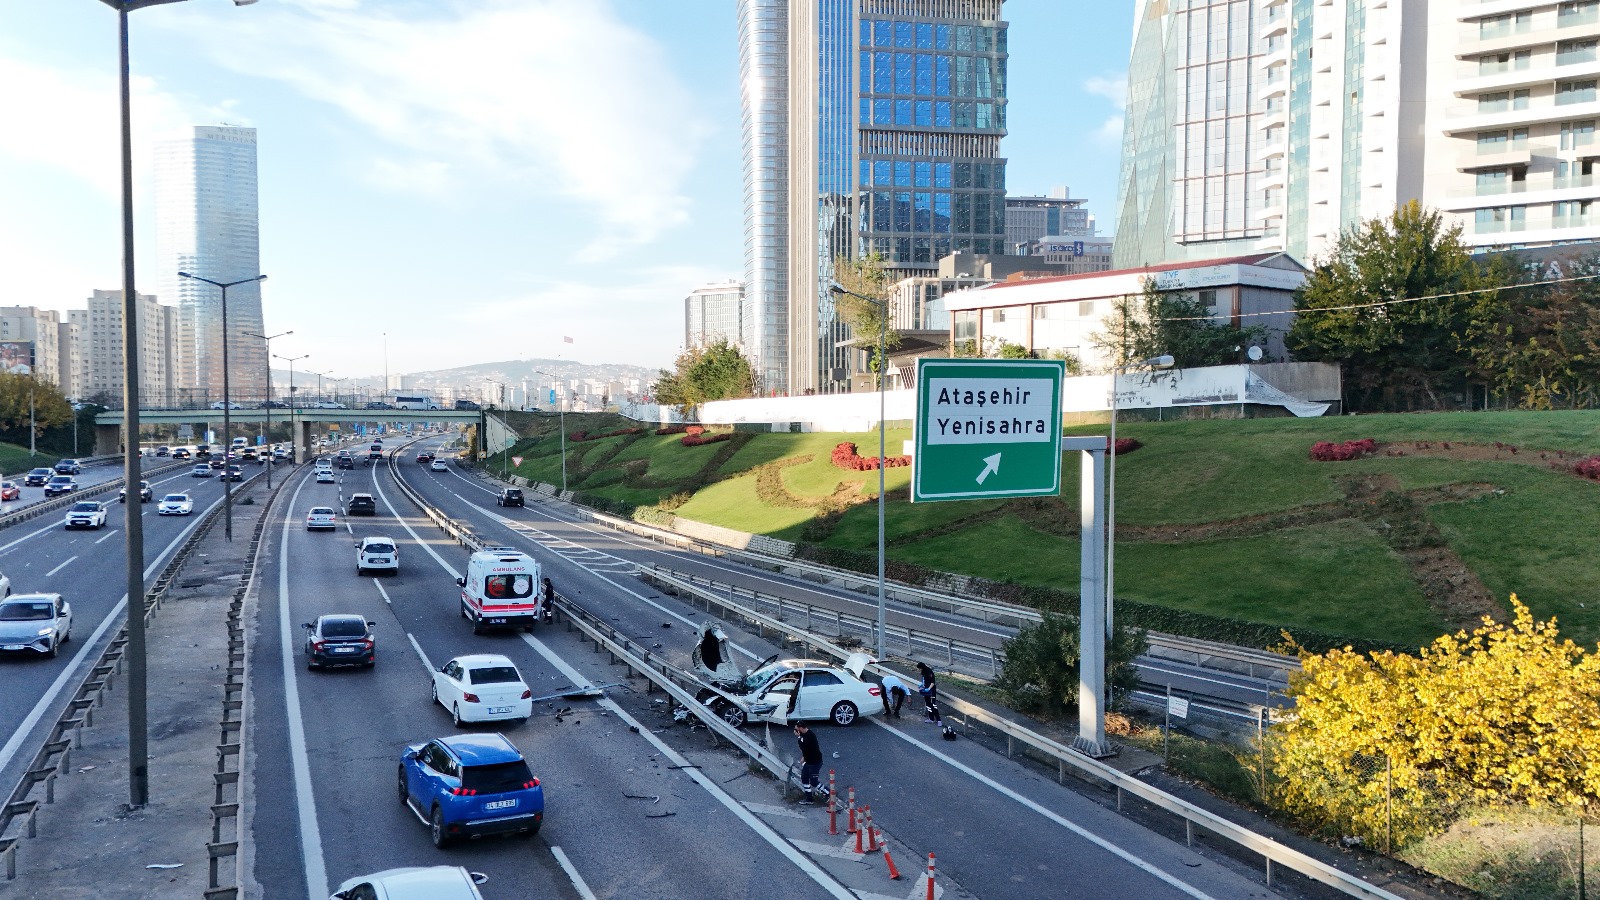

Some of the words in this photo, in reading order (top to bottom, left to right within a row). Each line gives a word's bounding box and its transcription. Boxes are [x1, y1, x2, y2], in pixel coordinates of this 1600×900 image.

[1164, 271, 1179, 279] TVF
[937, 386, 1031, 407] Ataşehir
[936, 416, 1045, 435] Yenisahra
